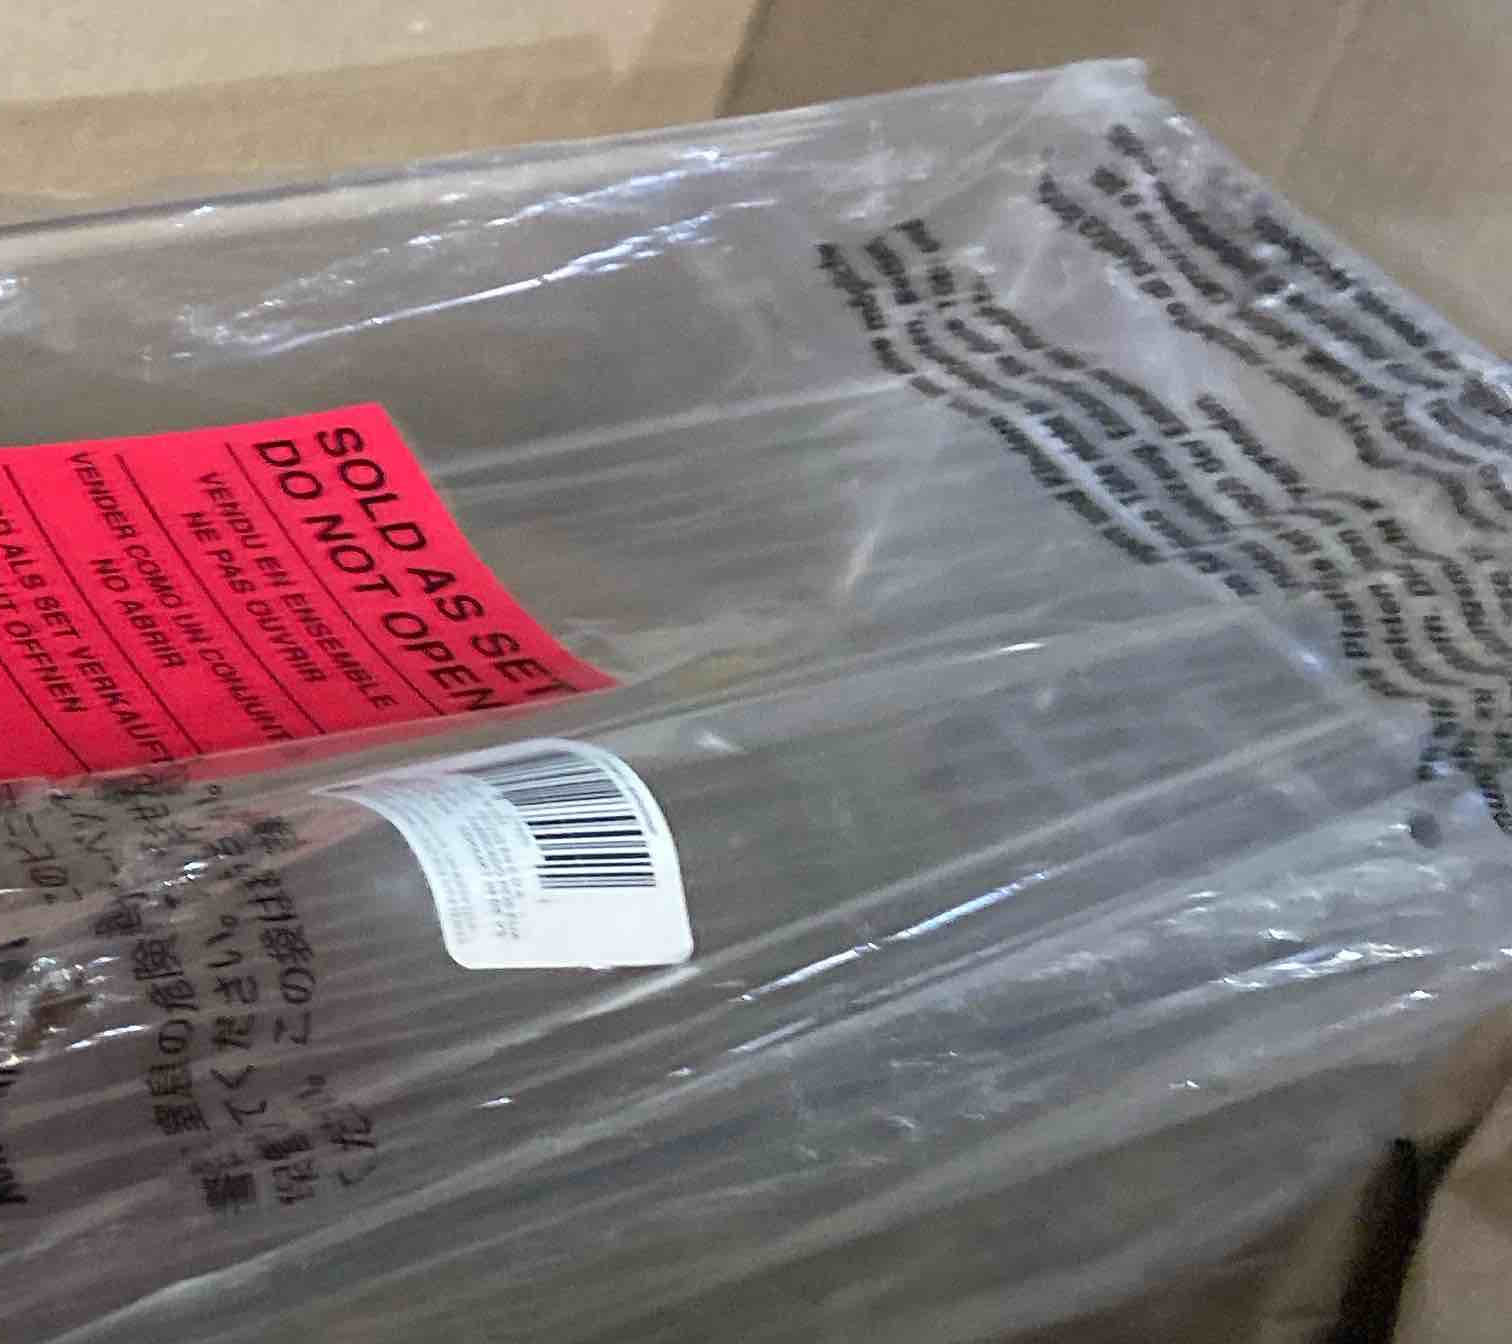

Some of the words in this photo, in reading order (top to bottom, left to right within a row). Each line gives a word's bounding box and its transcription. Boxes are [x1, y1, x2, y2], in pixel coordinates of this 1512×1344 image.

[33, 595, 83, 640] SET
[68, 450, 143, 541] VENDER
[125, 542, 185, 610] COMO
[173, 613, 217, 644] UN
[89, 556, 133, 593] NO
[118, 599, 188, 669] ABRIR
[180, 510, 219, 544] NE
[205, 548, 258, 595] PAS
[245, 598, 329, 685] OUVRIR
[195, 471, 267, 551] VENDU
[255, 555, 293, 592] EN
[285, 591, 400, 712] ENSEMBLE
[252, 438, 325, 501] DO
[303, 513, 401, 599] NOT
[380, 610, 506, 711] OPEN
[314, 426, 430, 554] SOLD
[406, 564, 486, 623] AS
[469, 631, 580, 699] SET
[3, 619, 90, 714] ÖFFNEN
